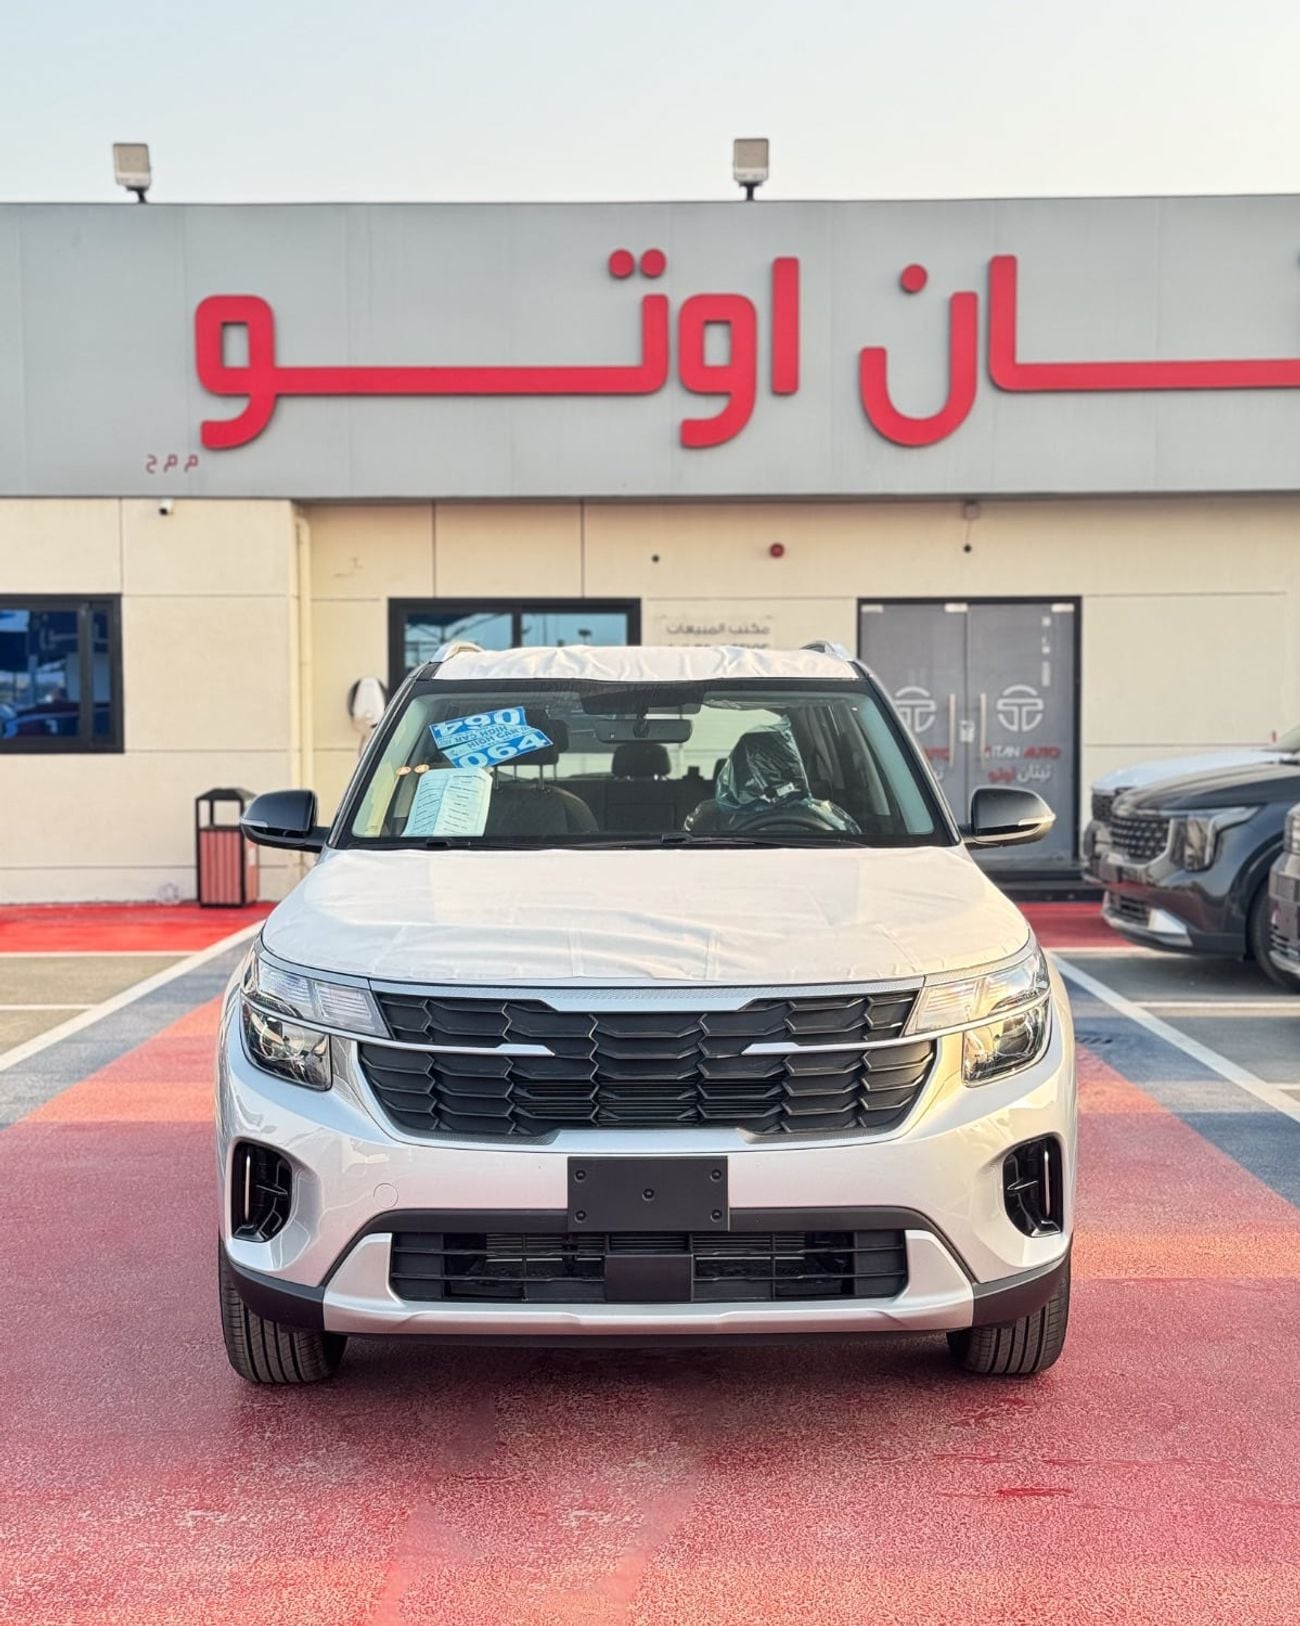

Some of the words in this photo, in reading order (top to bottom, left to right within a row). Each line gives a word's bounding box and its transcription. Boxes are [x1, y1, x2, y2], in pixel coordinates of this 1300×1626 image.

[195, 250, 799, 448] اوتو
[459, 733, 548, 768] 064
[1022, 745, 1060, 759] AUTO
